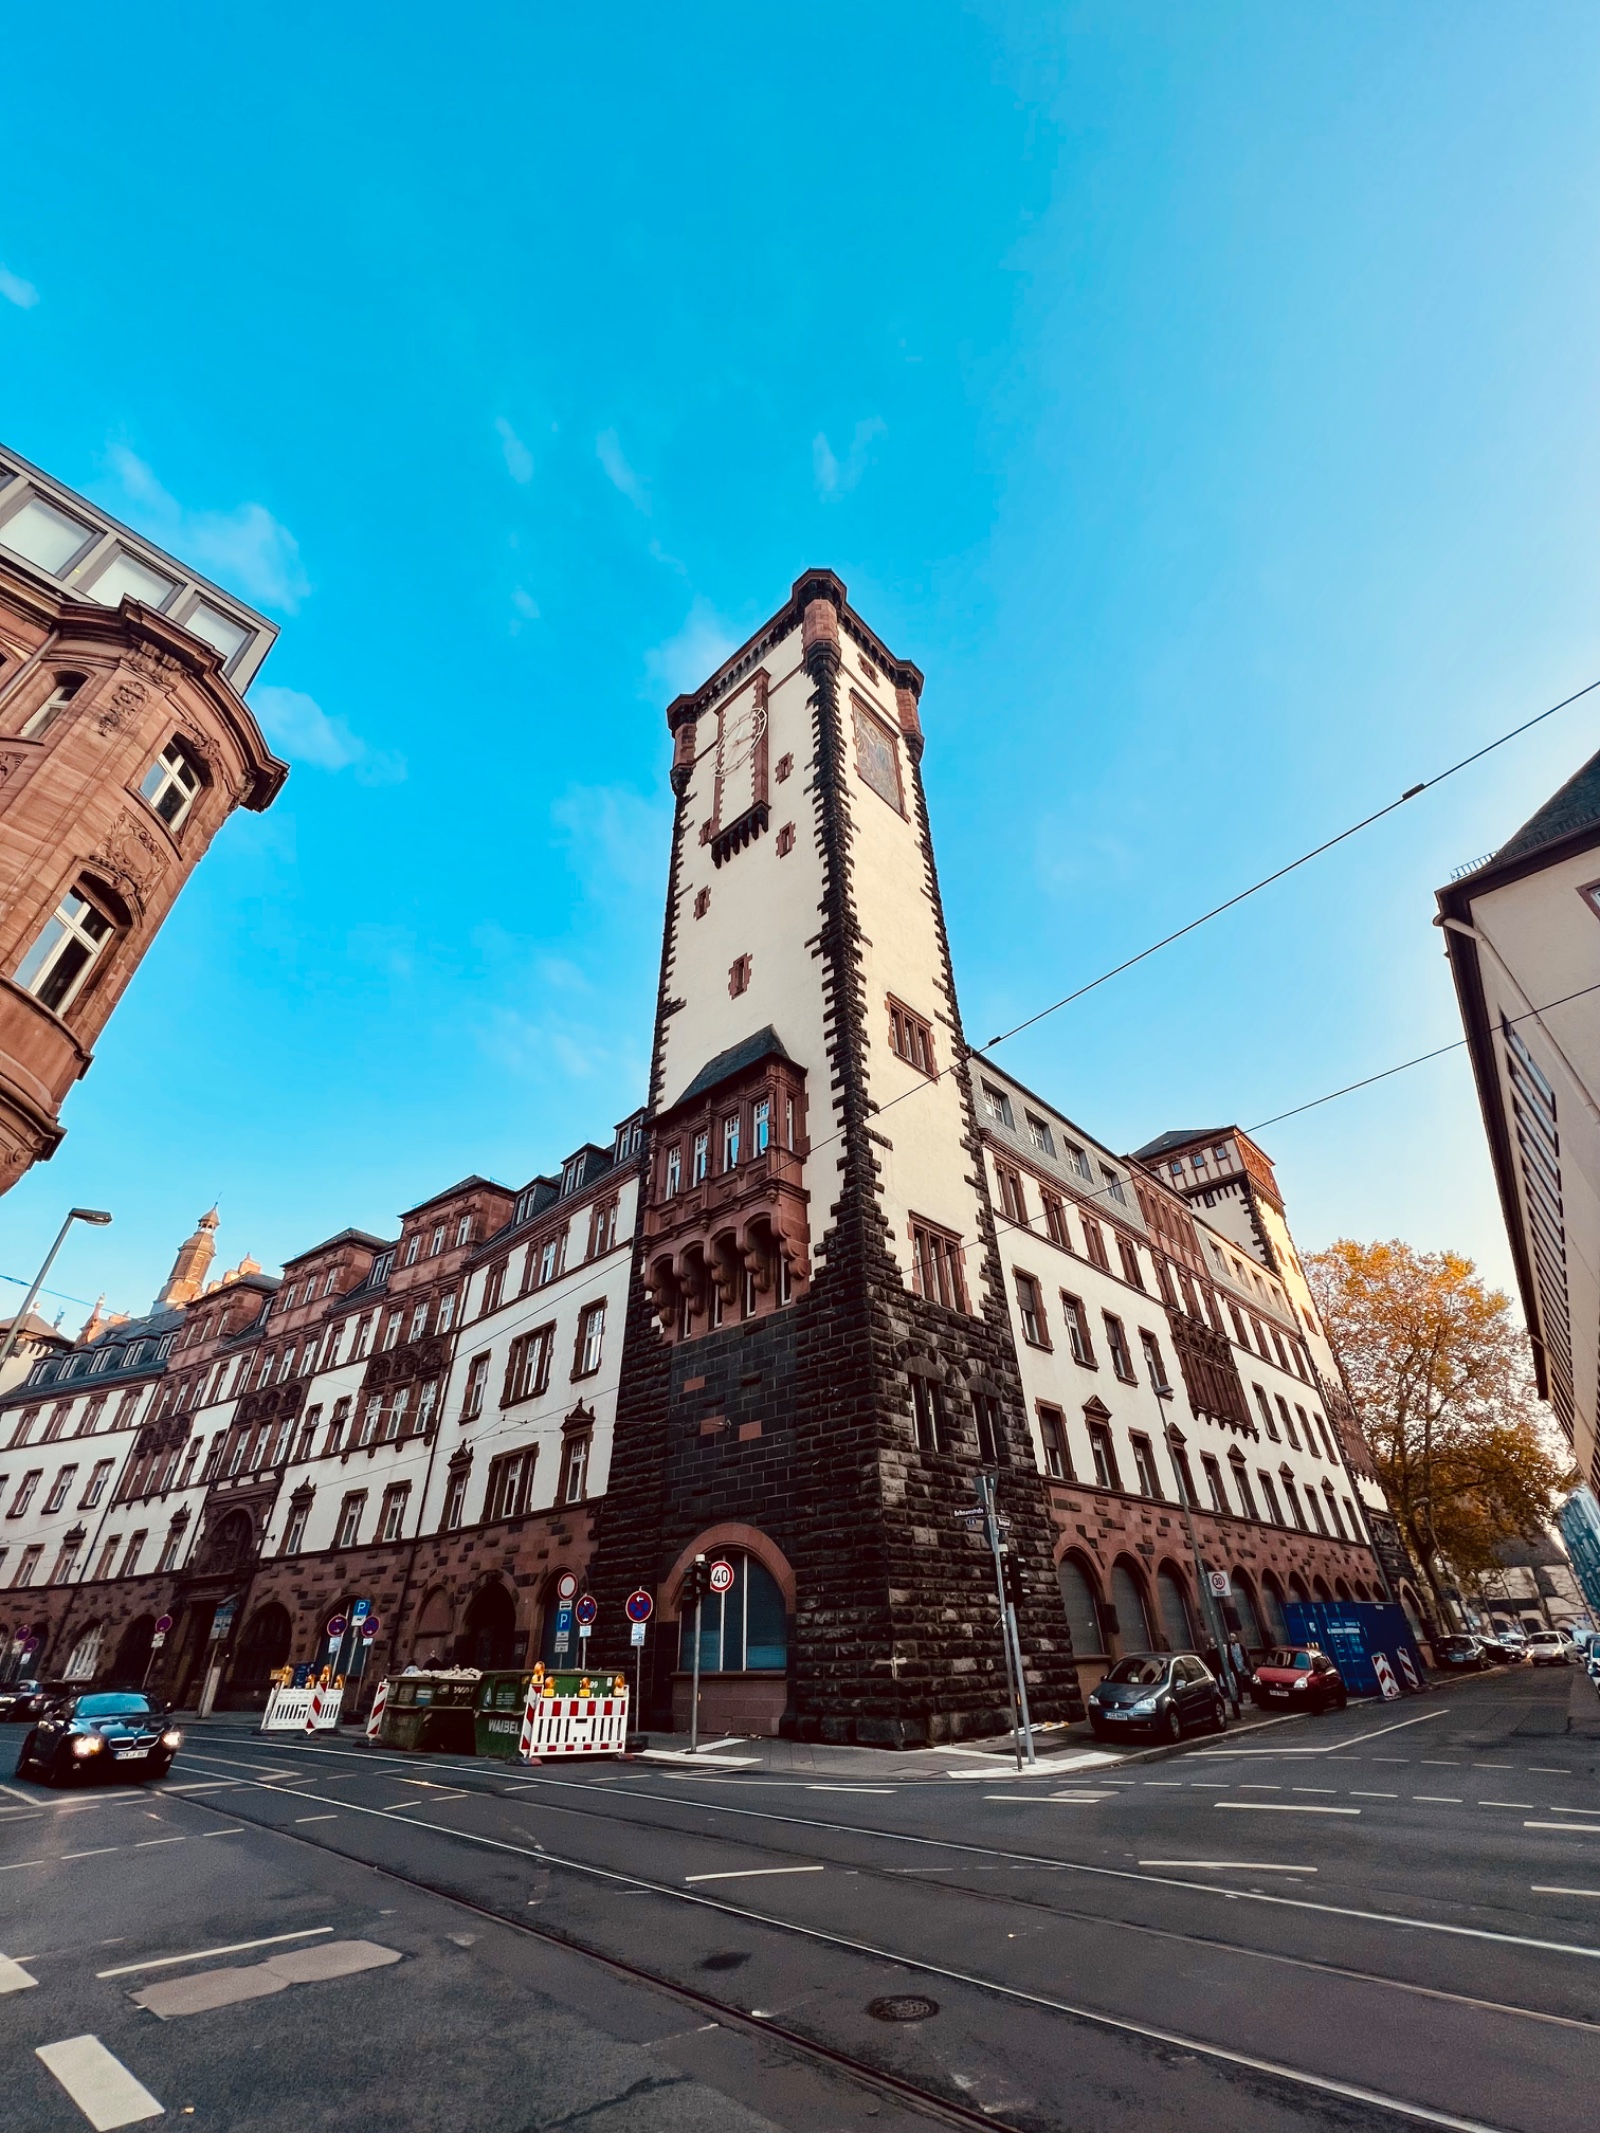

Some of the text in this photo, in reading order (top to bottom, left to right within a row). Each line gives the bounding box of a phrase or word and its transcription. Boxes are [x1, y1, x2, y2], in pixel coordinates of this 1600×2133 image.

[713, 1570, 728, 1583] 40
[1214, 1577, 1223, 1586] 30
[357, 1602, 366, 1613] P
[560, 1614, 568, 1628] P
[488, 1719, 520, 1734] WAIBEL
